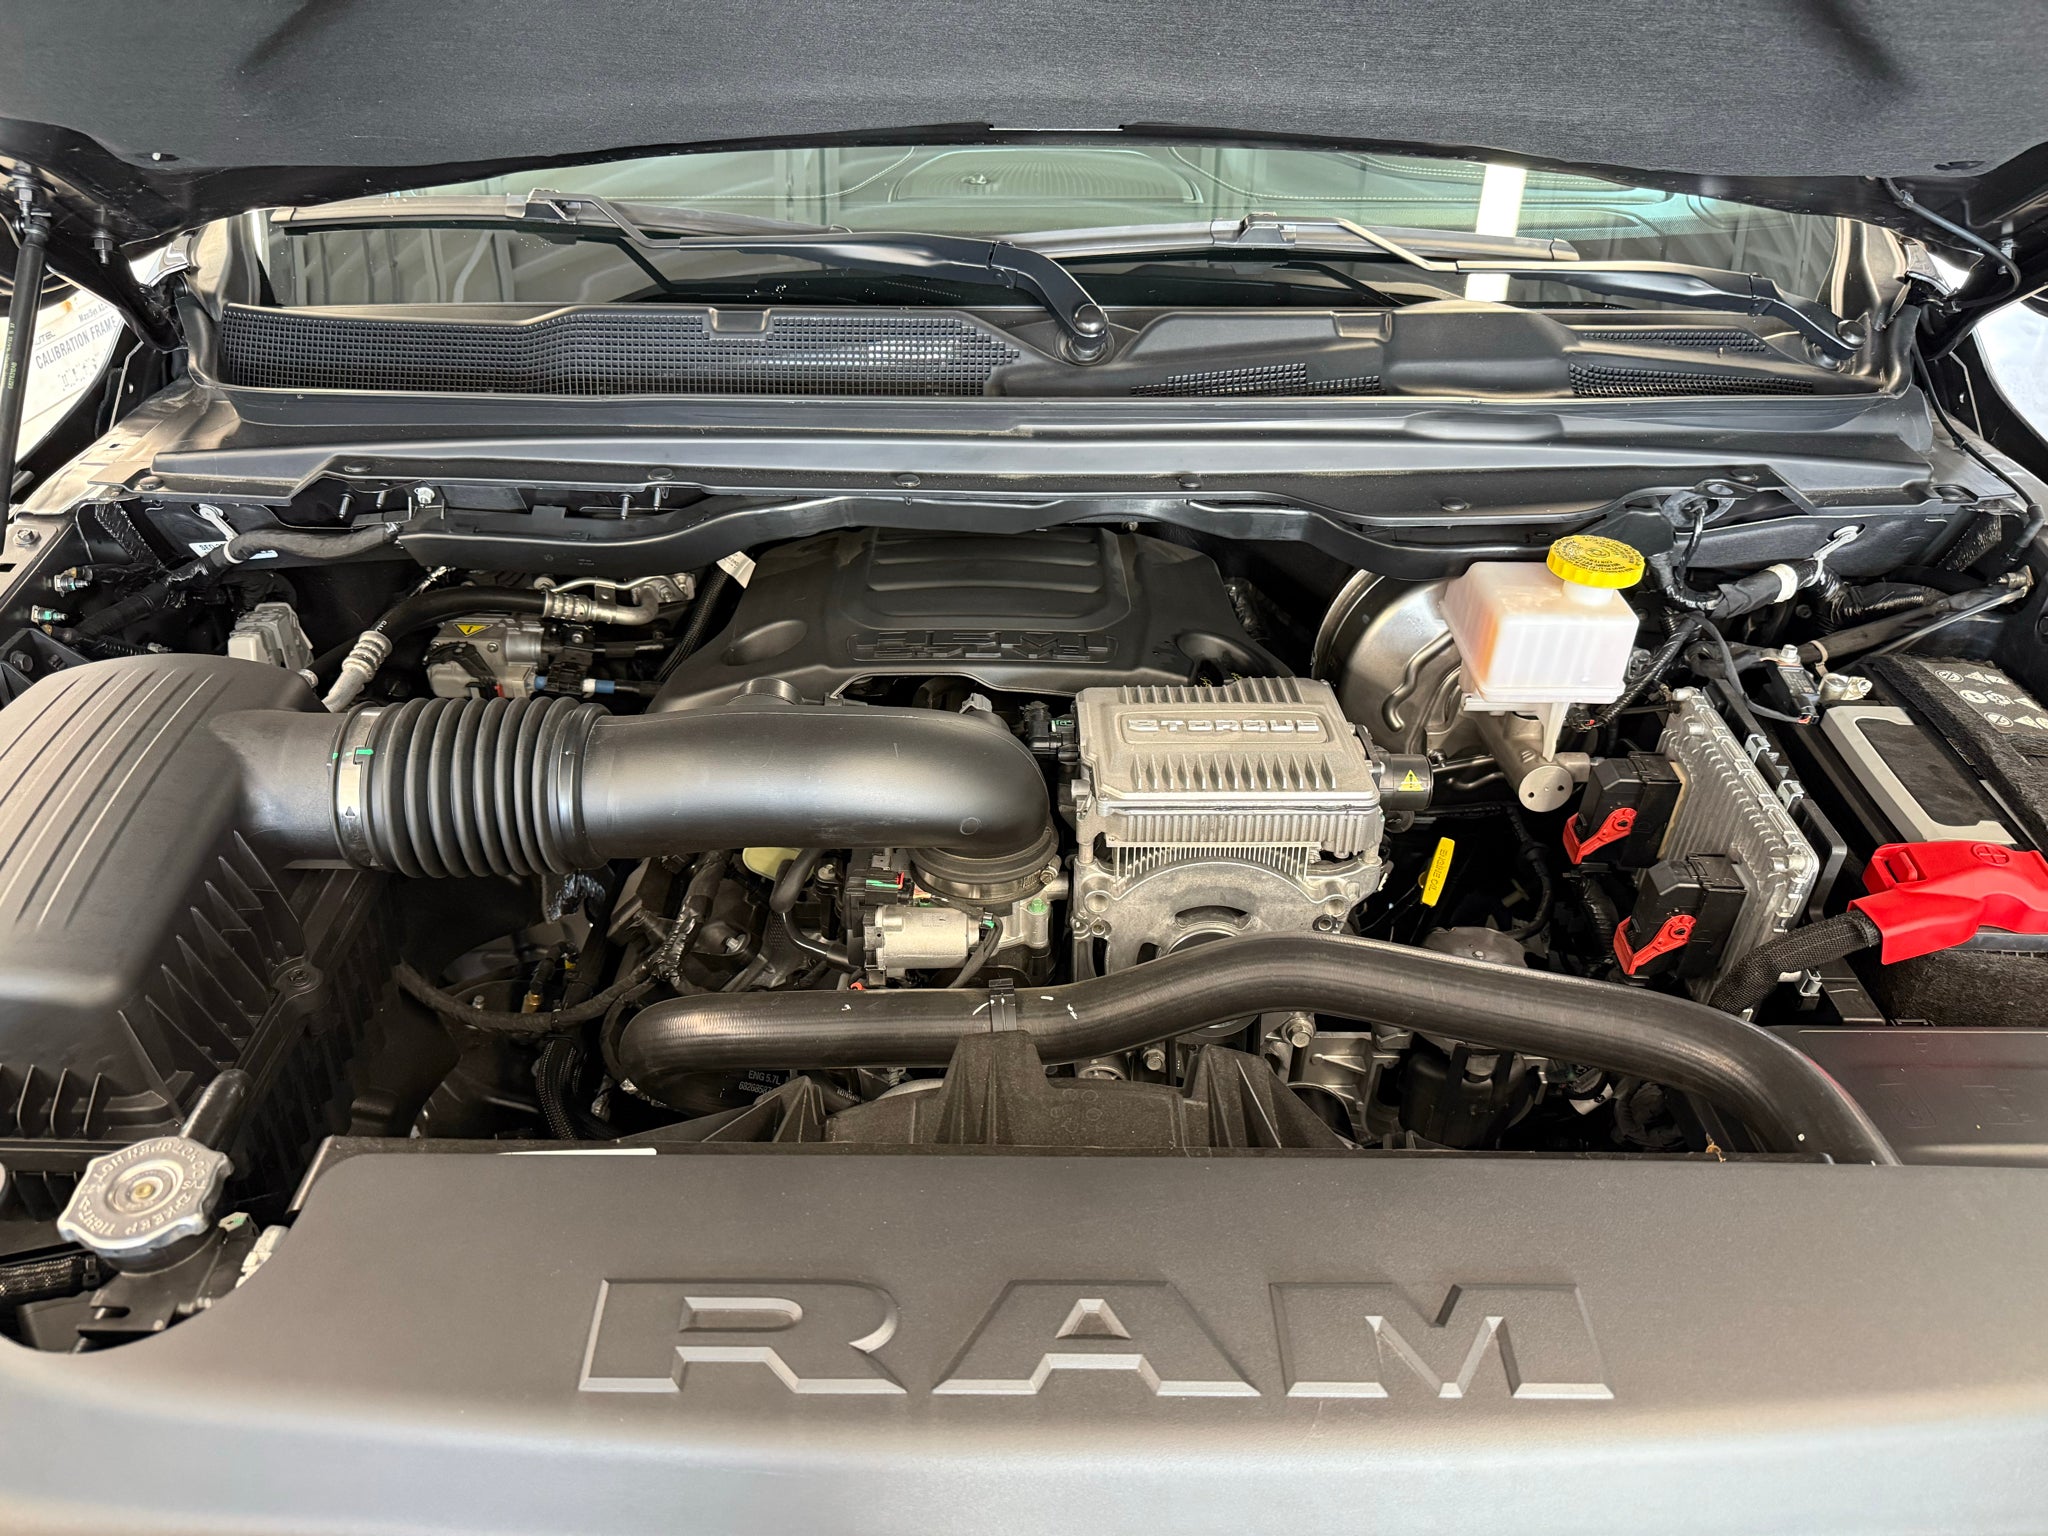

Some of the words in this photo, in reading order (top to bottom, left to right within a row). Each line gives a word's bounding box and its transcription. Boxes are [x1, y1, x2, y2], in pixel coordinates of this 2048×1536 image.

[35, 330, 90, 369] CALIBRATION
[89, 315, 118, 340] FRAME
[748, 1070, 765, 1081] ENG
[765, 1073, 781, 1085] 5.7L
[577, 1277, 1615, 1400] RAM
